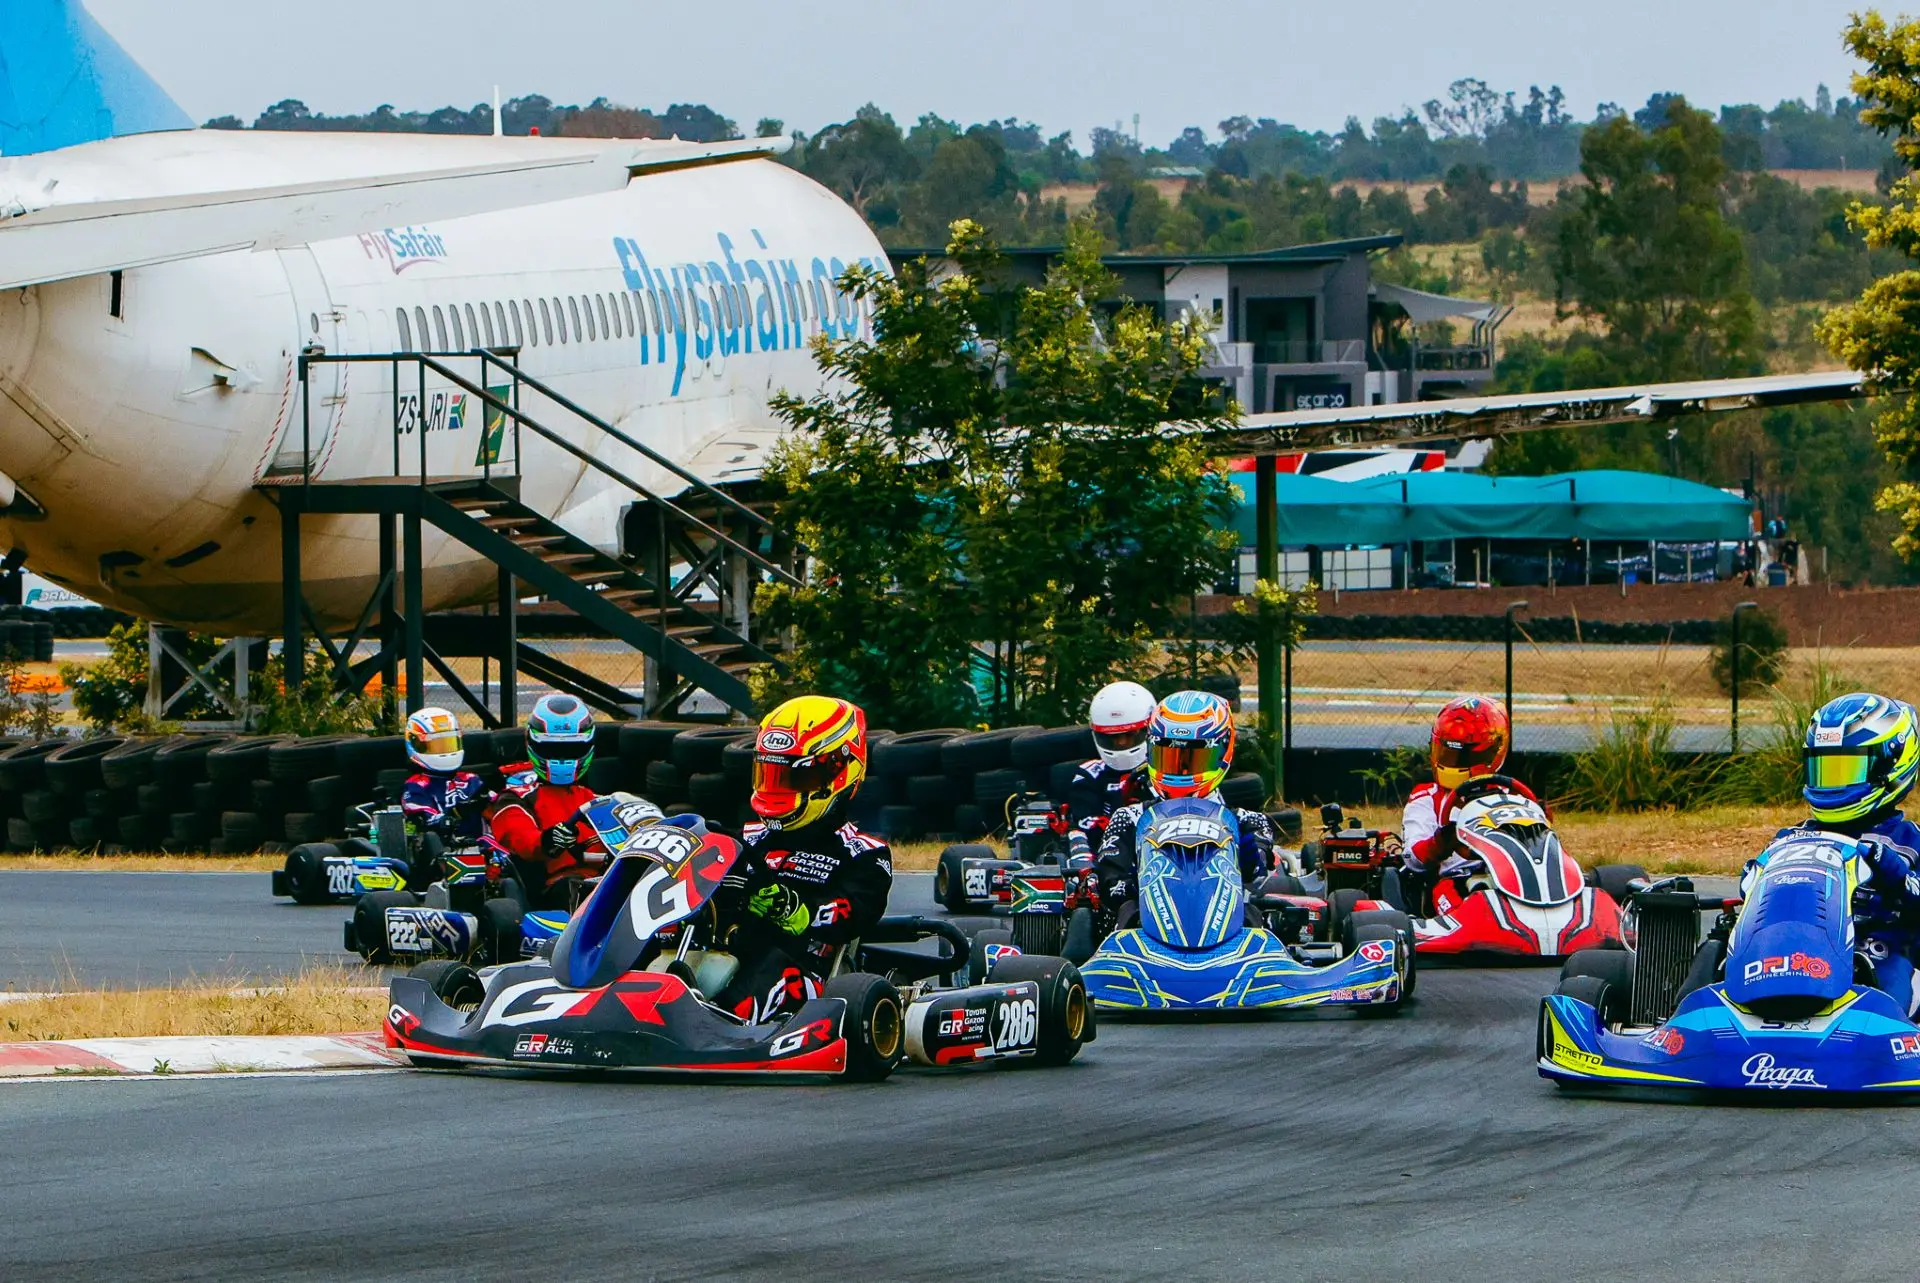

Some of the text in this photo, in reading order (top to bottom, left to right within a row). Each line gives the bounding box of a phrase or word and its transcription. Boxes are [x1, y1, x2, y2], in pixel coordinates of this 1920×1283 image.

[357, 226, 448, 275] FlySafair
[766, 733, 791, 746] Arai
[1158, 818, 1222, 844] 296
[787, 856, 833, 872] GAZOO
[795, 850, 841, 866] TOYOTA
[1337, 852, 1362, 860] RMC
[326, 864, 356, 894] 282
[782, 862, 830, 880] Racing
[811, 897, 852, 927] GR
[388, 921, 422, 951] 222
[1744, 971, 1810, 986] ENGINEERING
[480, 970, 687, 1030] GR
[389, 1003, 421, 1037] GR
[939, 1020, 963, 1034] GR
[997, 999, 1036, 1049] 286
[769, 1018, 833, 1057] GR
[1554, 1042, 1602, 1065] STRETTO
[1741, 1053, 1828, 1090] Praga
